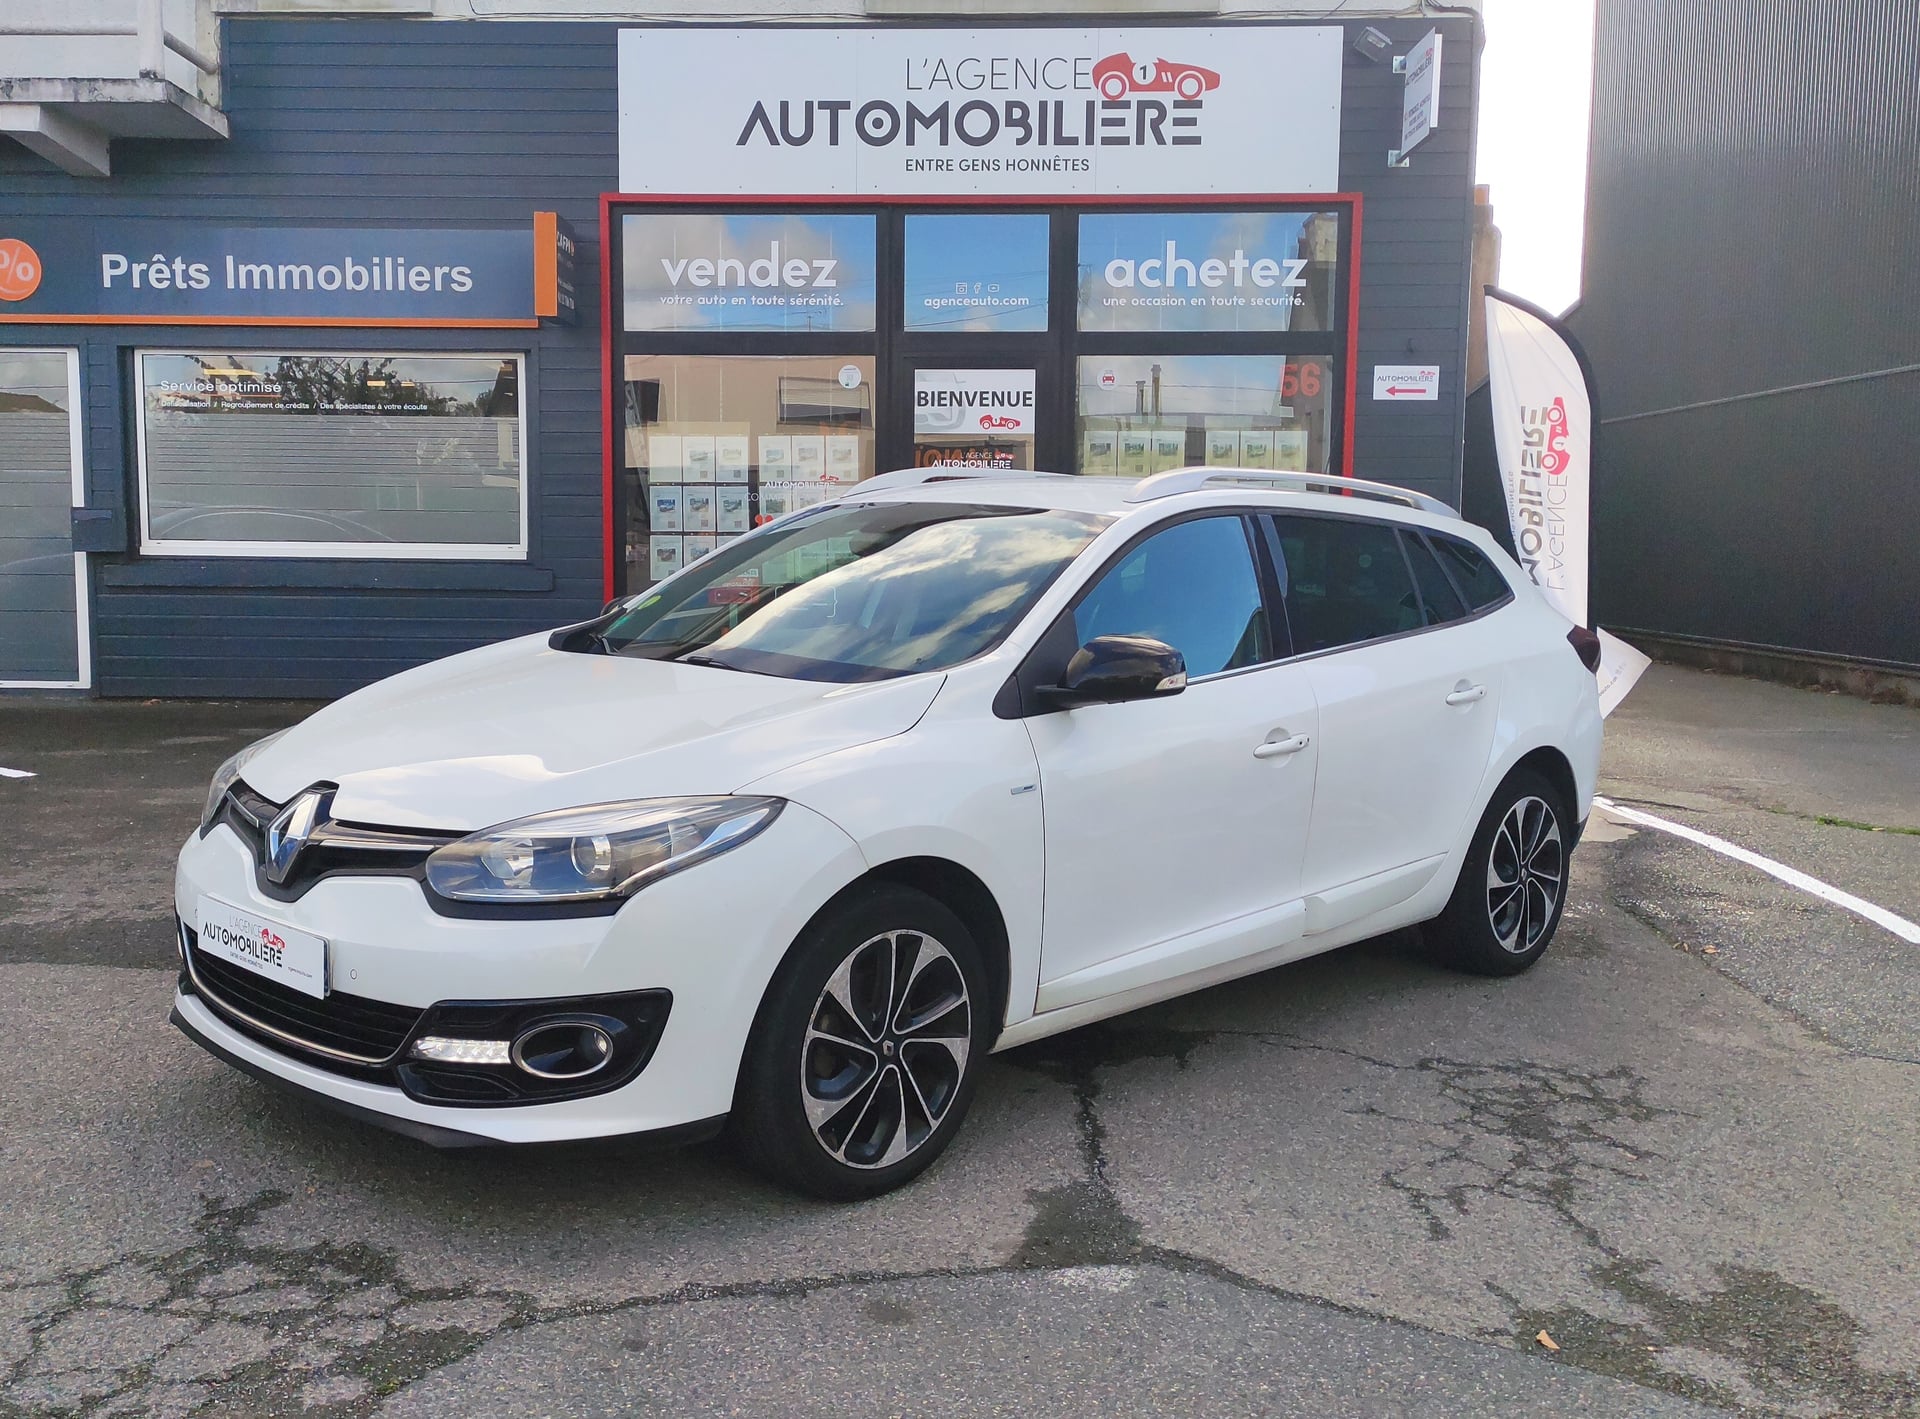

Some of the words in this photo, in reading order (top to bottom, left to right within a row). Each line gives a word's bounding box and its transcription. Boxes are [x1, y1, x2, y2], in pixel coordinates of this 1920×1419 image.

[906, 57, 1092, 90] L'AGENCE
[905, 158, 954, 172] ENTRE
[958, 158, 1001, 172] GENS
[1005, 154, 1090, 172] HONNÊTES
[102, 253, 211, 290] Prêts
[226, 255, 474, 292] Immobiliers
[660, 241, 838, 288] vendez
[1104, 240, 1308, 288] achetez
[660, 294, 693, 307] votre
[699, 294, 727, 306] auto
[731, 297, 747, 306] en
[751, 295, 785, 307] toute
[789, 293, 844, 307] sérénité.
[924, 295, 1030, 310] agenceauto.com
[1103, 296, 1127, 306] une
[1131, 295, 1186, 306] occasion
[1190, 297, 1206, 306] en
[1210, 294, 1246, 306] toute
[160, 380, 215, 392] Service
[219, 382, 282, 395] optimisé
[1281, 364, 1321, 398] 56
[221, 401, 273, 410] Regroupement
[917, 390, 1033, 407] BIENVENUE
